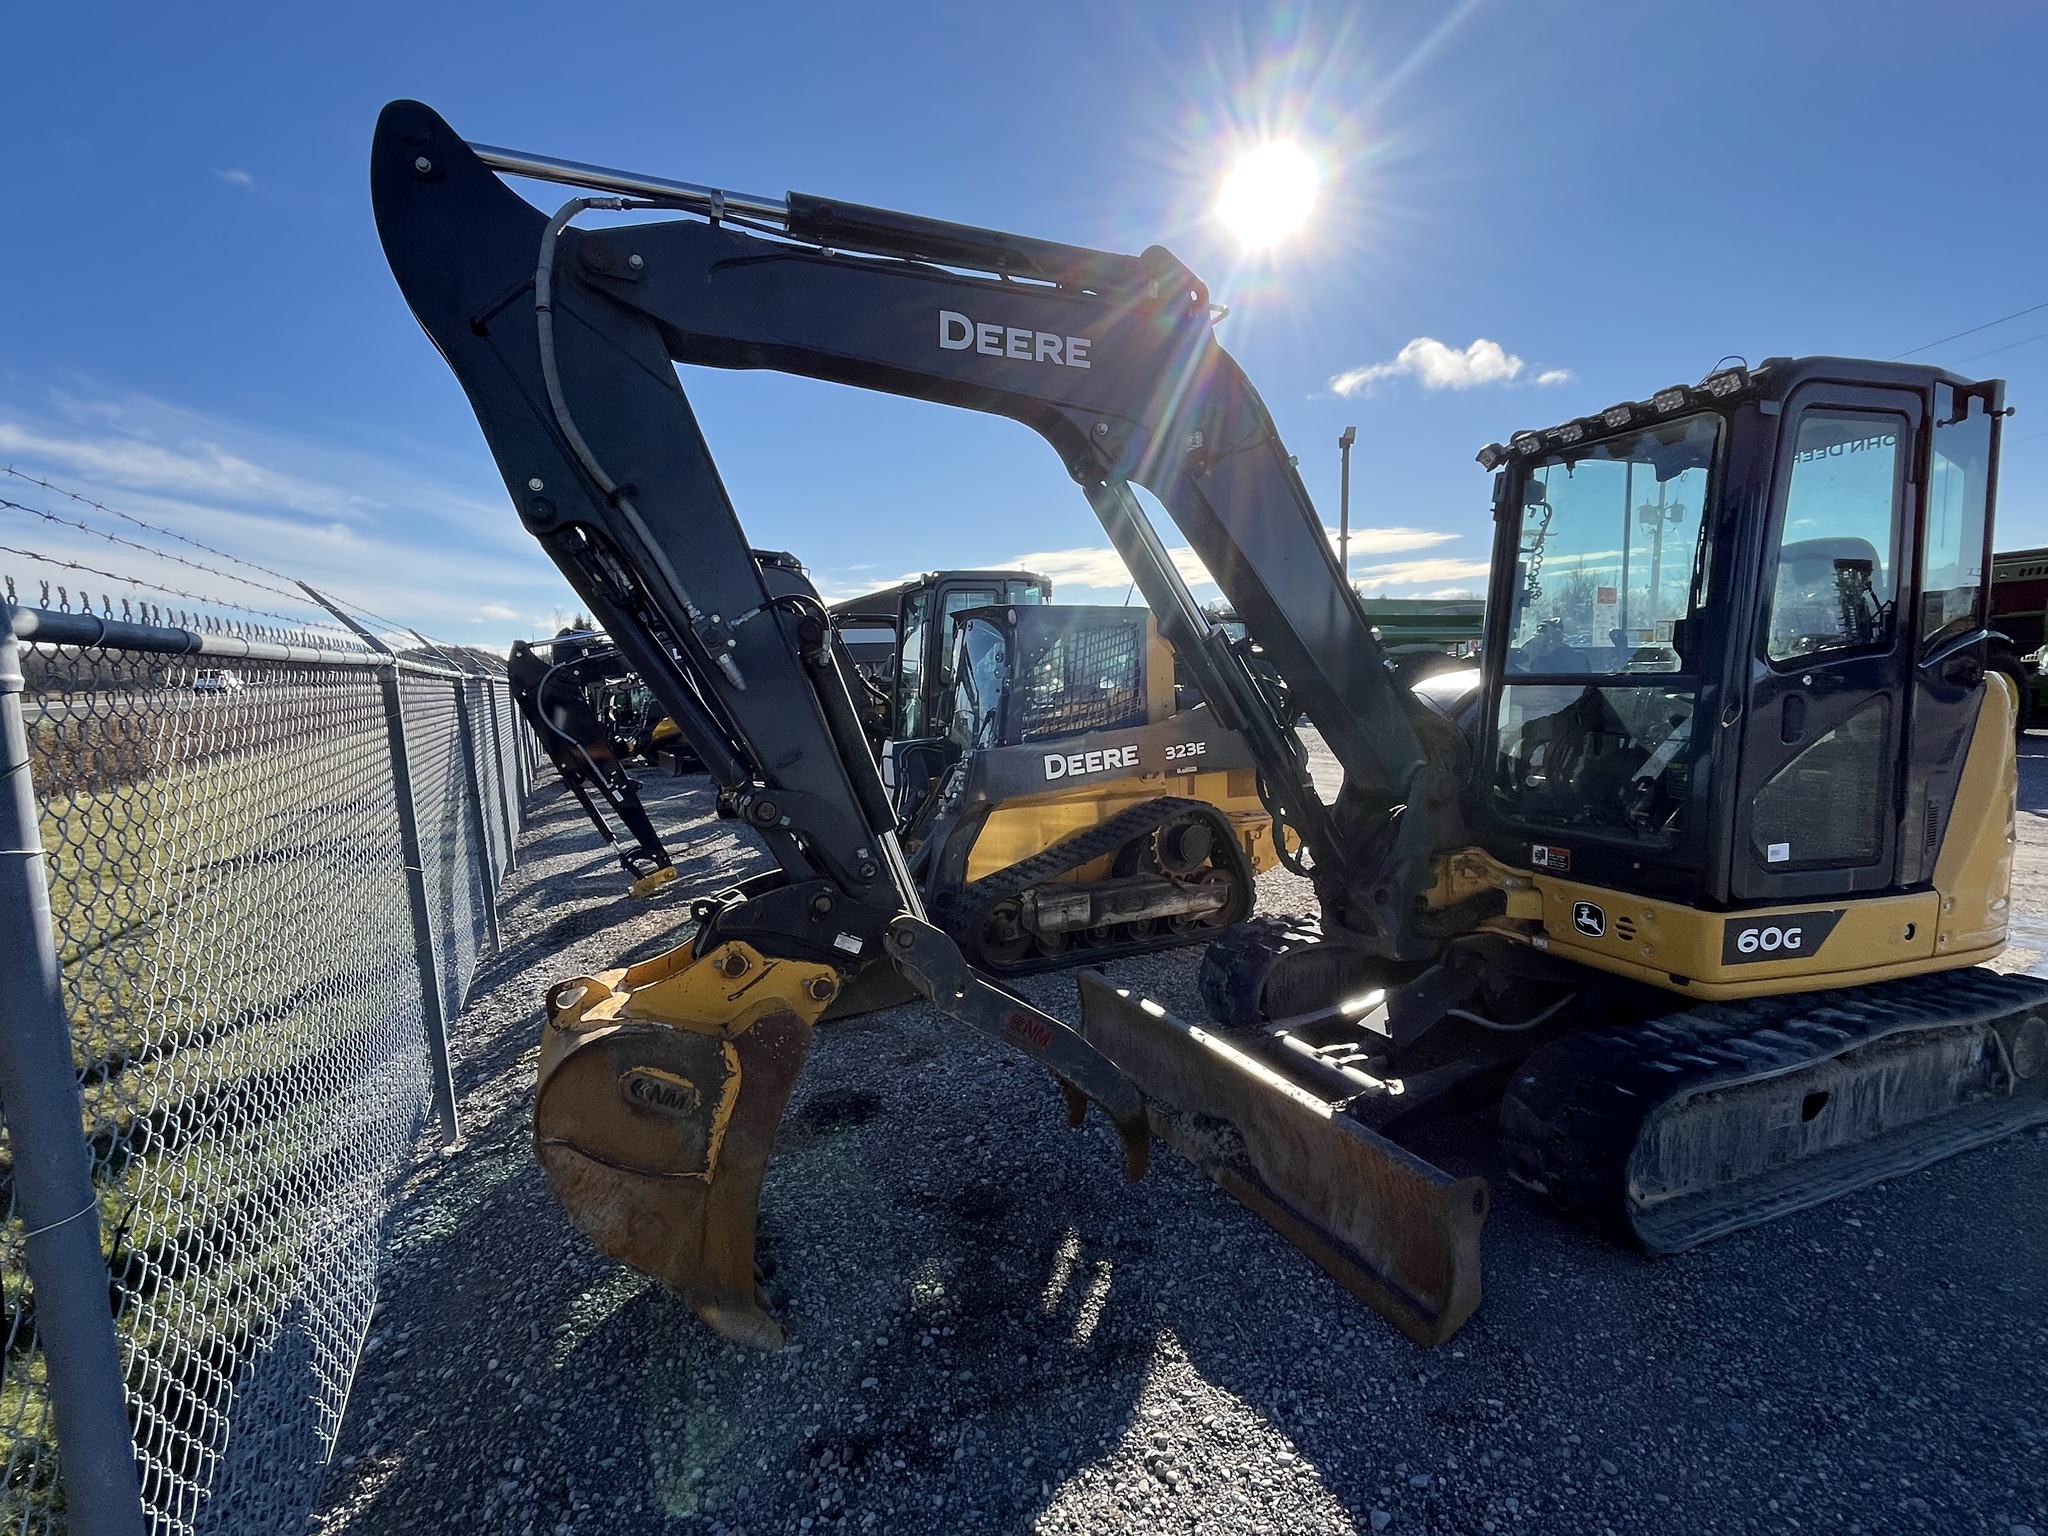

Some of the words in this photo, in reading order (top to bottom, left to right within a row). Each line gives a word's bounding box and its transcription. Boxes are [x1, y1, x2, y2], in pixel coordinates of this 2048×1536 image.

[939, 310, 1091, 369] DEERE
[1044, 745, 1139, 780] DEERE
[1164, 742, 1207, 760] 323E
[1737, 927, 1802, 953] 60G
